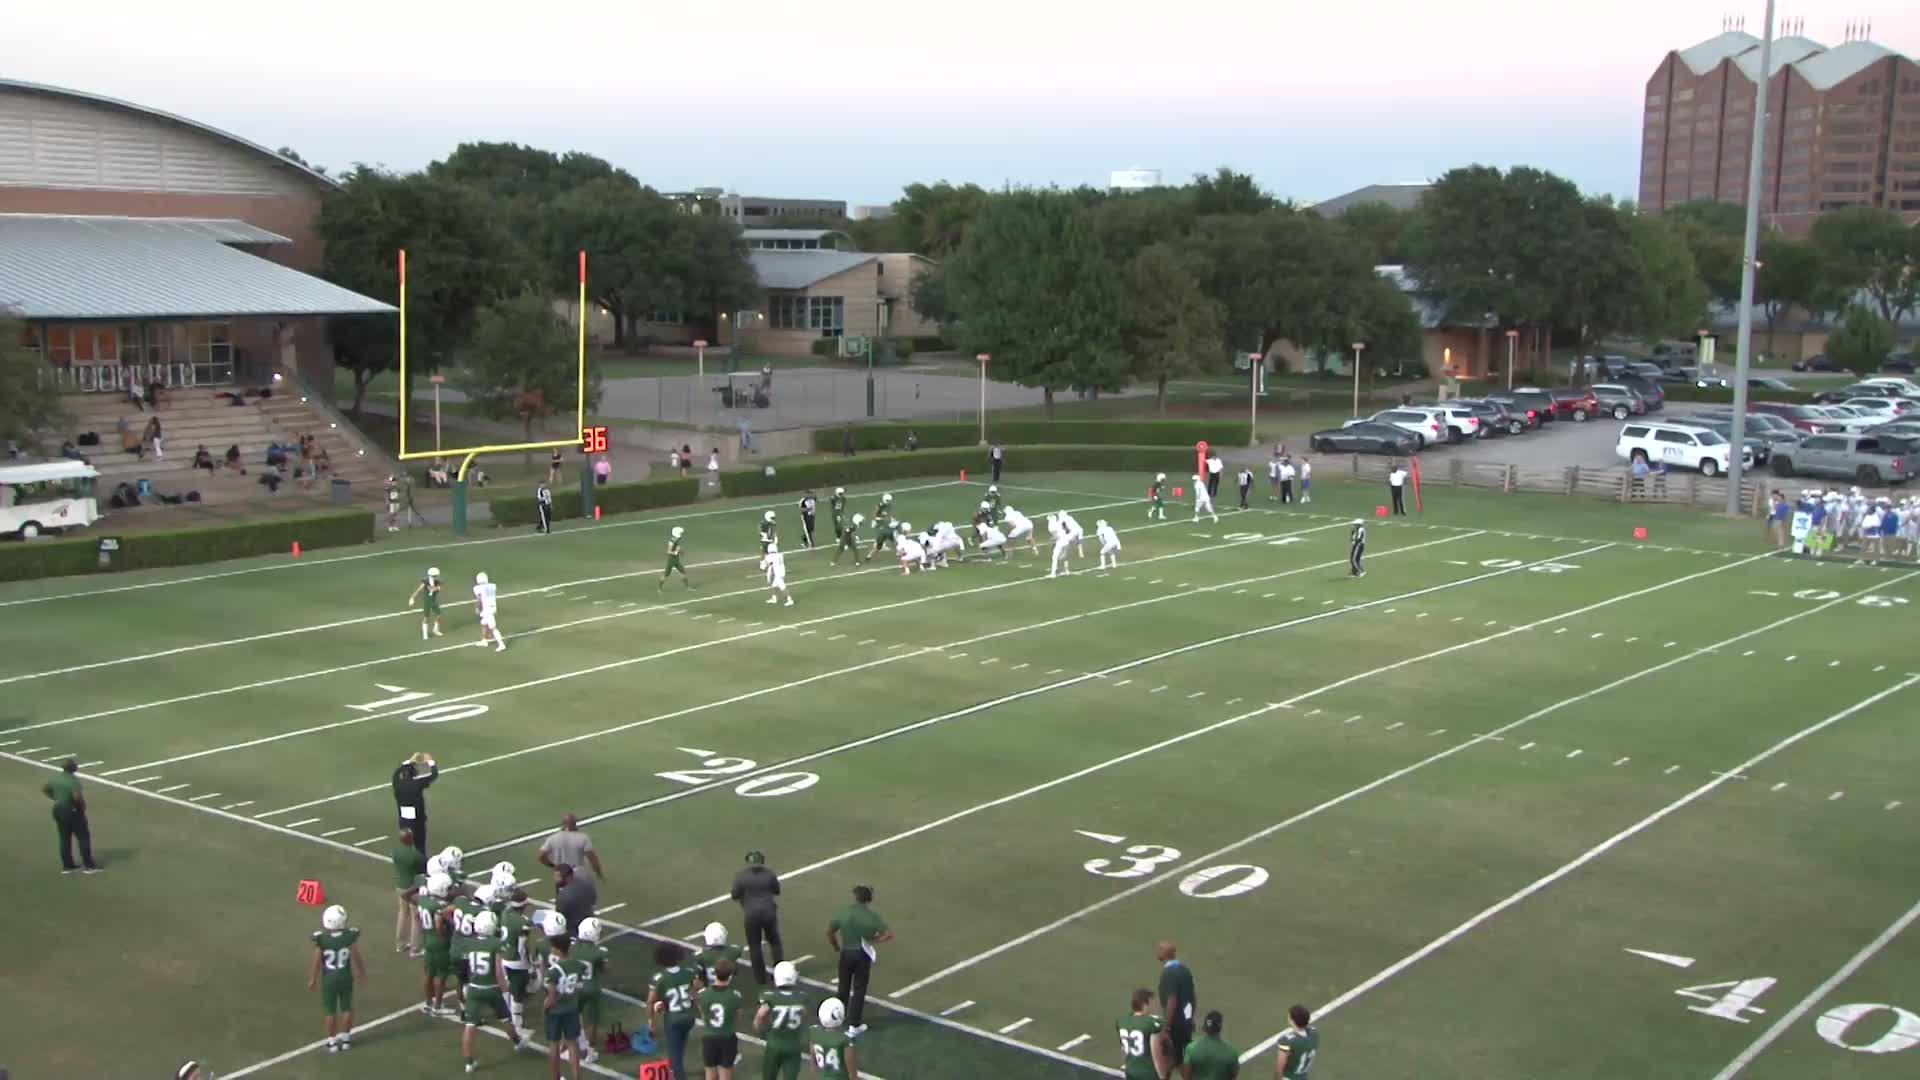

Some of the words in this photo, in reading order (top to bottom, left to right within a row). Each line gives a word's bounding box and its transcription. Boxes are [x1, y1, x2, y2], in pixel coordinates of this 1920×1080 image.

[583, 427, 606, 452] 36
[344, 692, 488, 723] 10
[654, 757, 819, 796] 20
[1083, 845, 1269, 898] 30
[298, 883, 315, 902] 20
[468, 951, 491, 975] 15
[666, 984, 692, 1012] 25
[709, 1003, 725, 1028] 3
[772, 1005, 801, 1030] 75
[1675, 977, 1920, 1053] 40
[812, 1044, 840, 1071] 64
